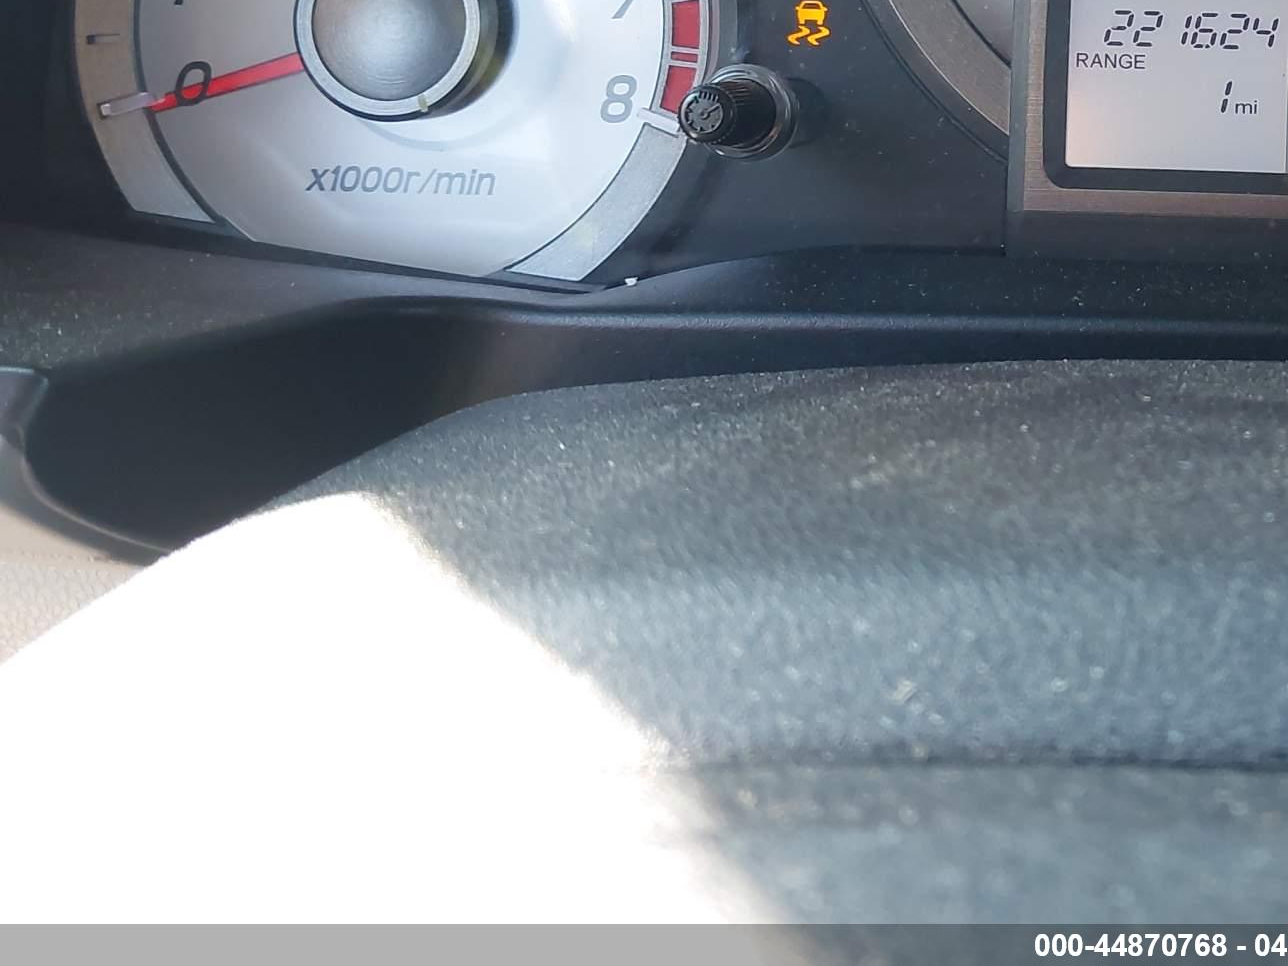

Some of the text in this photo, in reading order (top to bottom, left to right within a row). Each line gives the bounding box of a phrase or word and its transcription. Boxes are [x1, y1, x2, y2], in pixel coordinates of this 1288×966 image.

[1103, 9, 1280, 50] 221624
[1075, 52, 1147, 70] RANGE
[175, 60, 212, 106] 0
[599, 74, 638, 124] 8
[1219, 80, 1258, 116] 1 mi
[304, 164, 497, 197] x1000r/min
